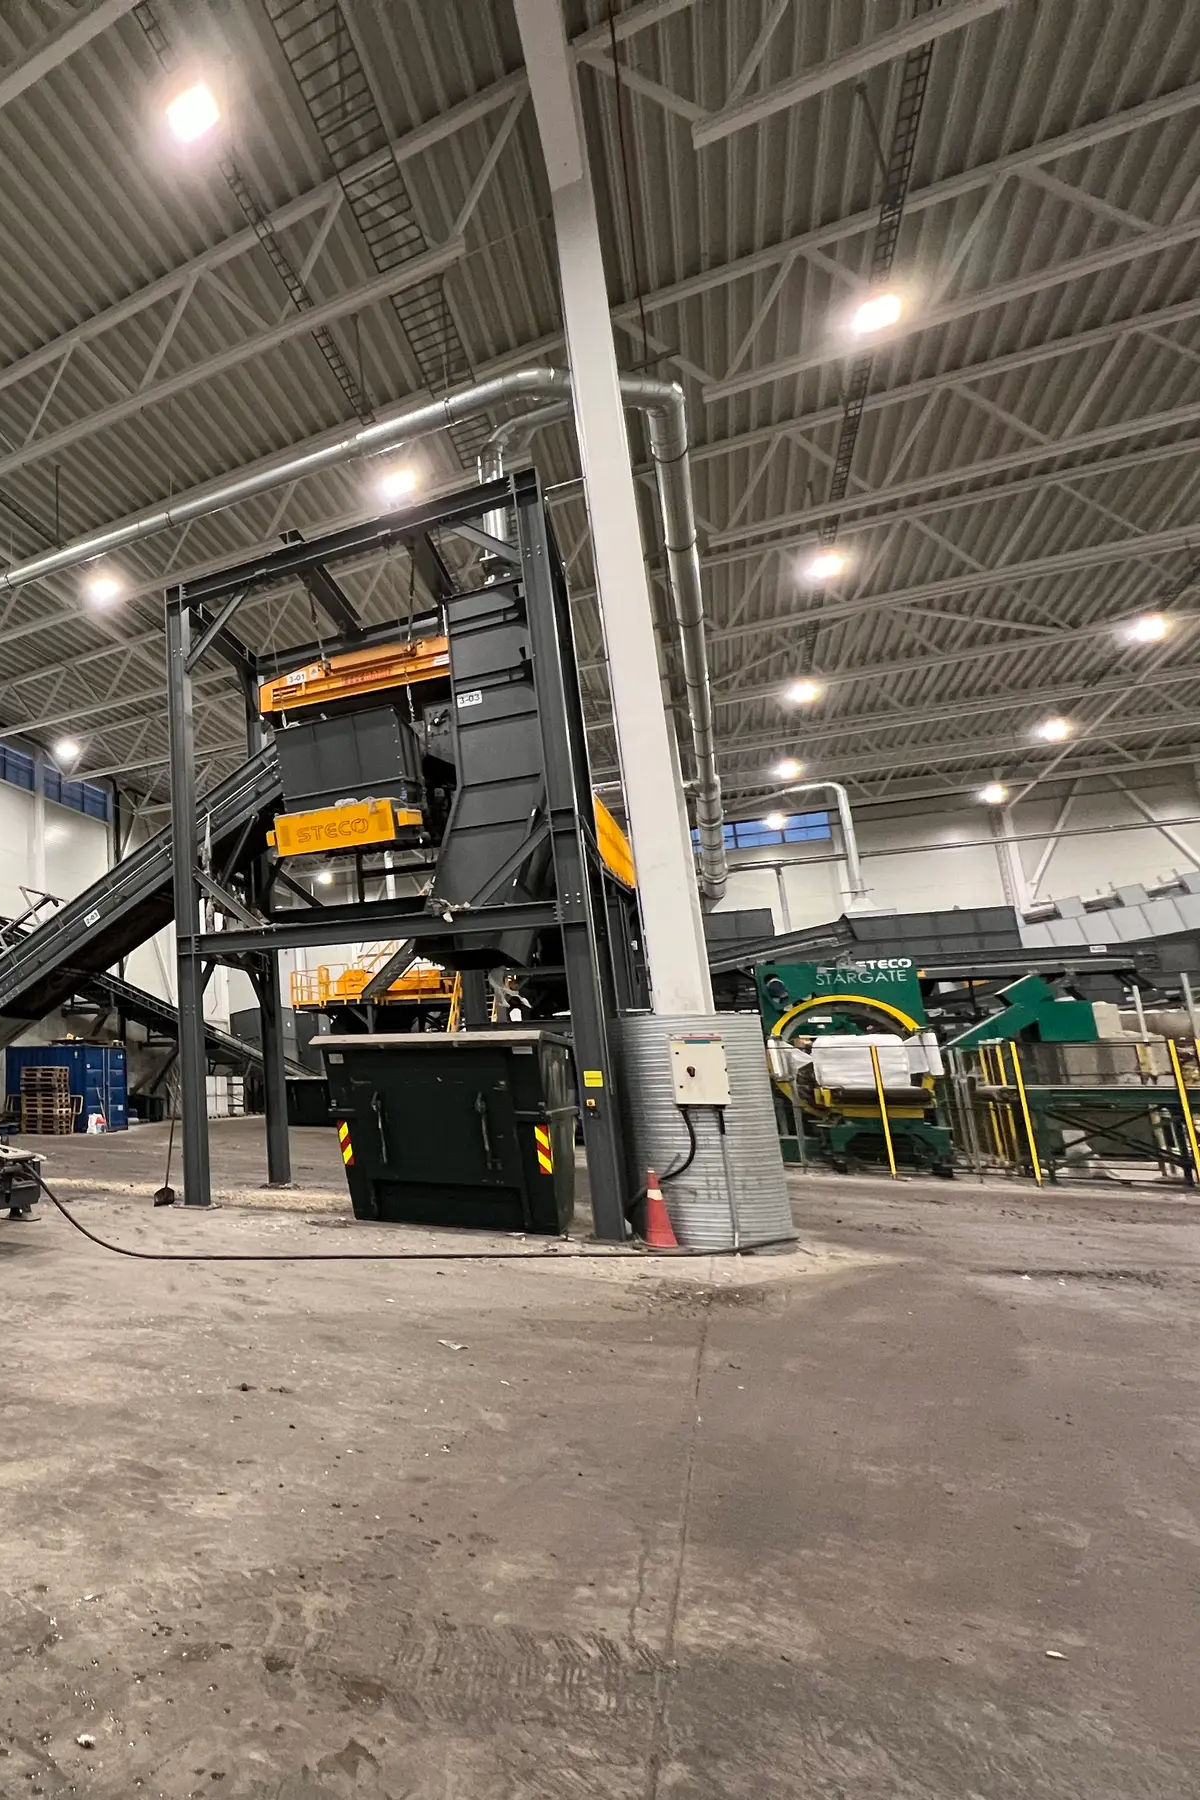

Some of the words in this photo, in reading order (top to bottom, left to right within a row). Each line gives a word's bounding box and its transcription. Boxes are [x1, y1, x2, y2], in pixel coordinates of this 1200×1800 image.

[288, 673, 305, 684] 3-01
[459, 693, 481, 705] 3-03
[296, 818, 369, 843] STECO
[815, 969, 908, 986] STARGATE
